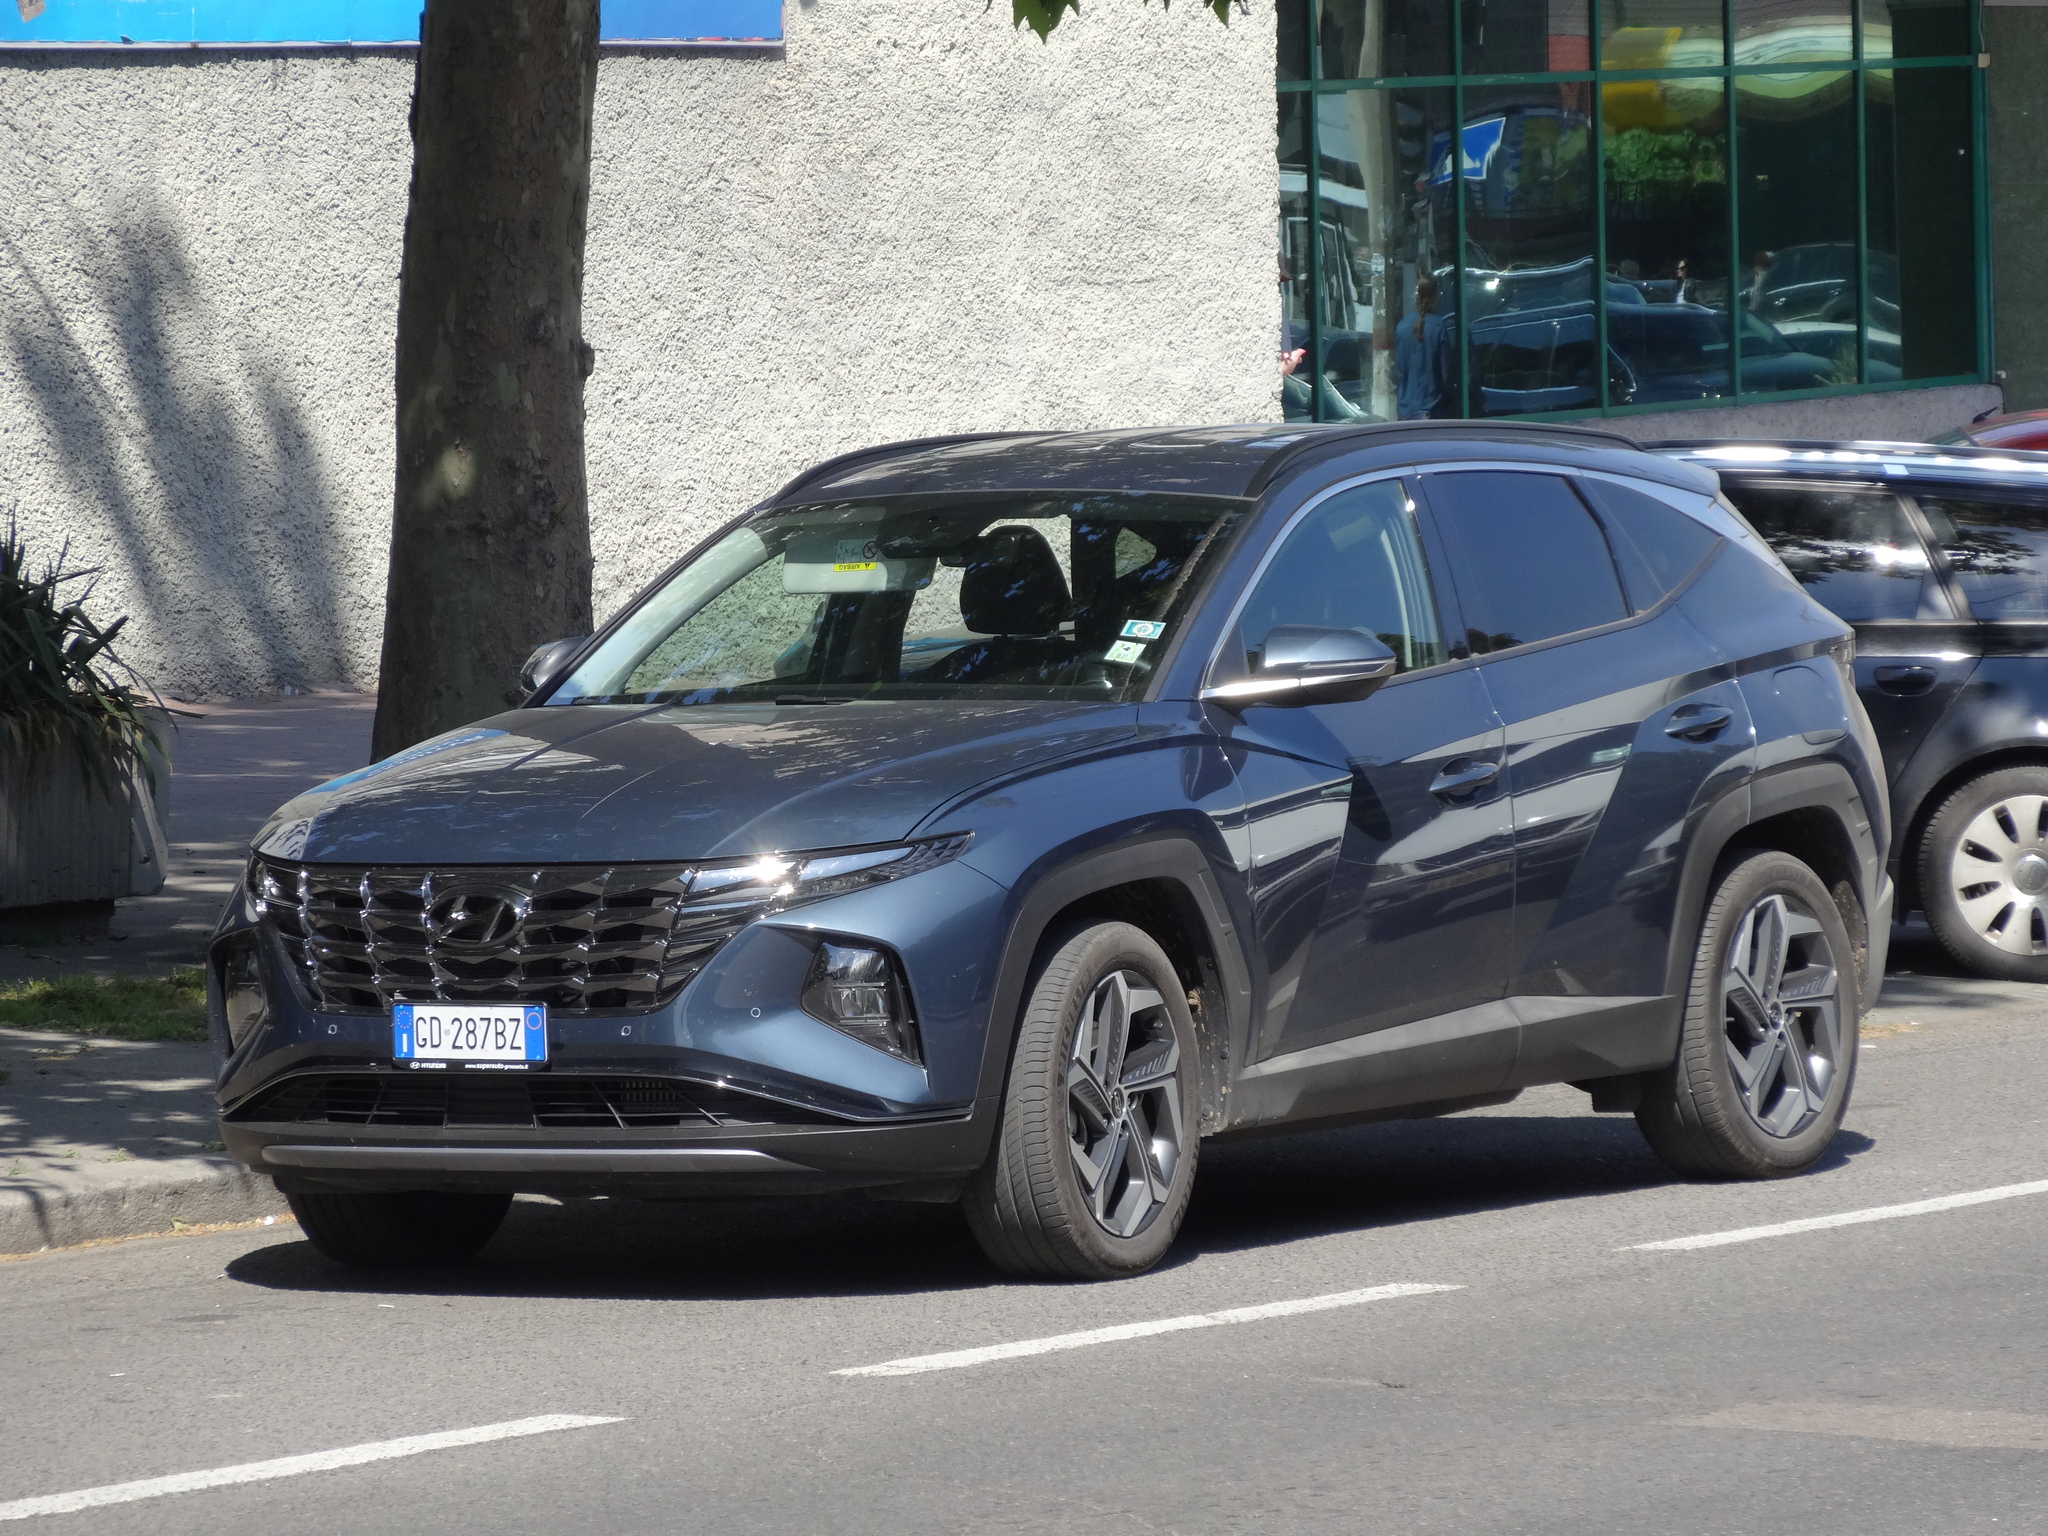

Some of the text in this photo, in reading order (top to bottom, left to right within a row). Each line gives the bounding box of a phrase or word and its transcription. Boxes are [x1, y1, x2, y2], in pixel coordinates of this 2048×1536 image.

[402, 1033, 408, 1053] I
[415, 1016, 522, 1050] GD 287BZ
